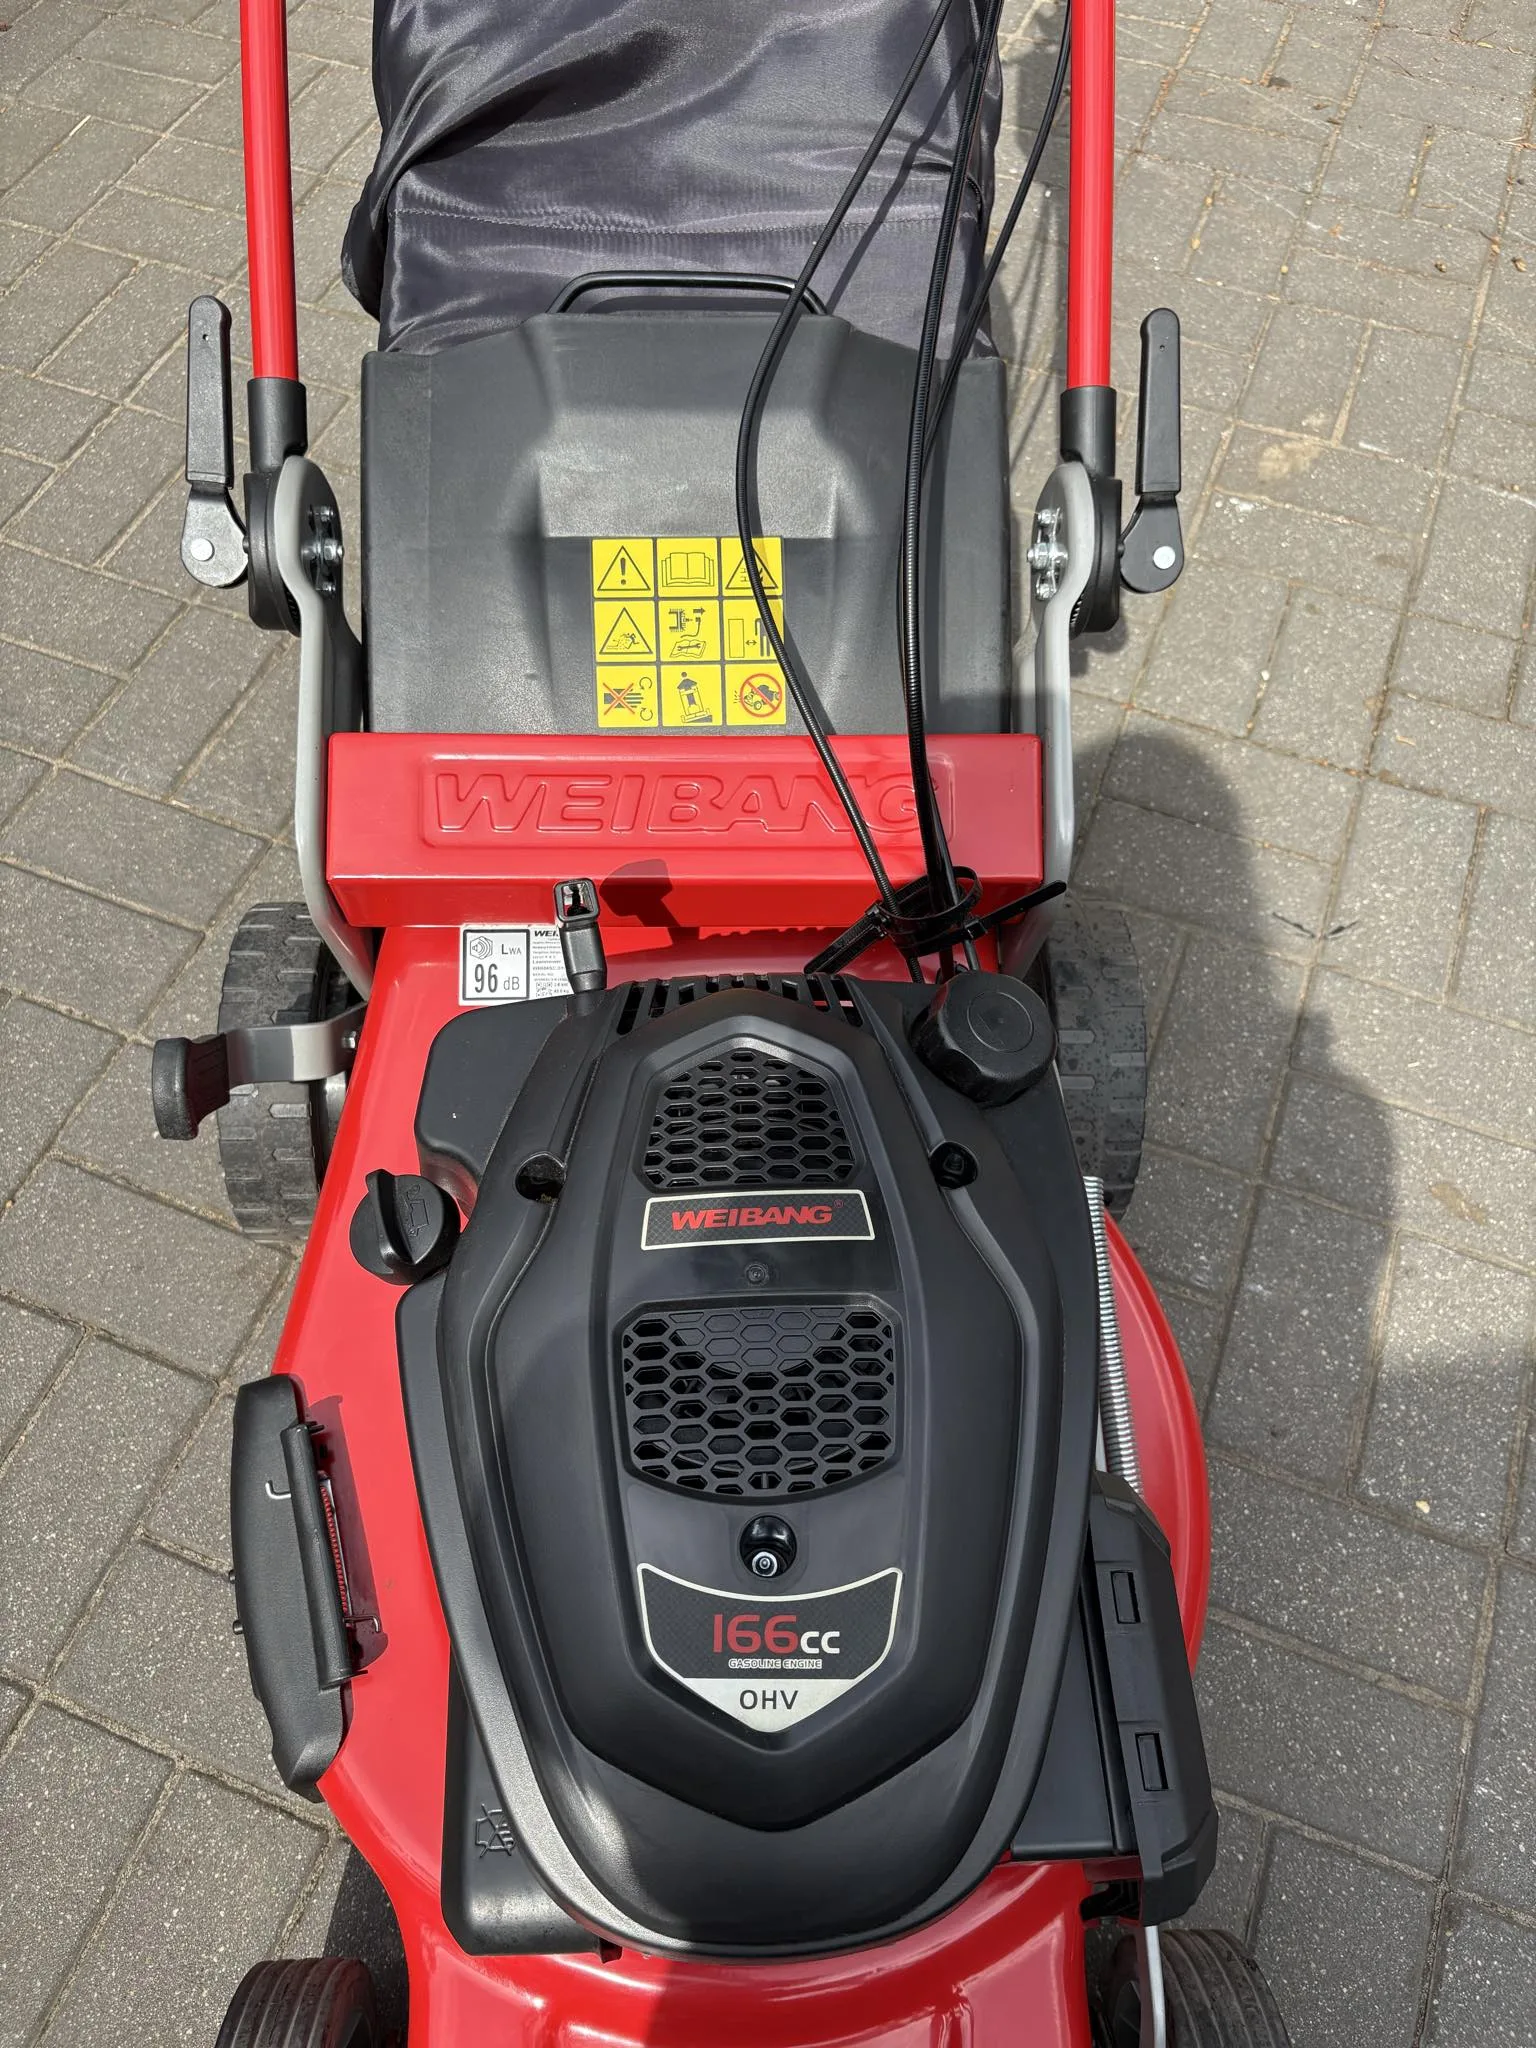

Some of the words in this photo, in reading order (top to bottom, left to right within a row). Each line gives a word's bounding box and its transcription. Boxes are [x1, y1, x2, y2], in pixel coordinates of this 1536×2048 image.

[434, 772, 938, 833] WEIBANG
[474, 963, 498, 993] 96
[503, 976, 520, 990] dB
[671, 1205, 834, 1231] WEIBANG
[728, 1658, 782, 1670] GASOLINE
[783, 1658, 823, 1670] ENGINE
[739, 1689, 800, 1710] OHV
